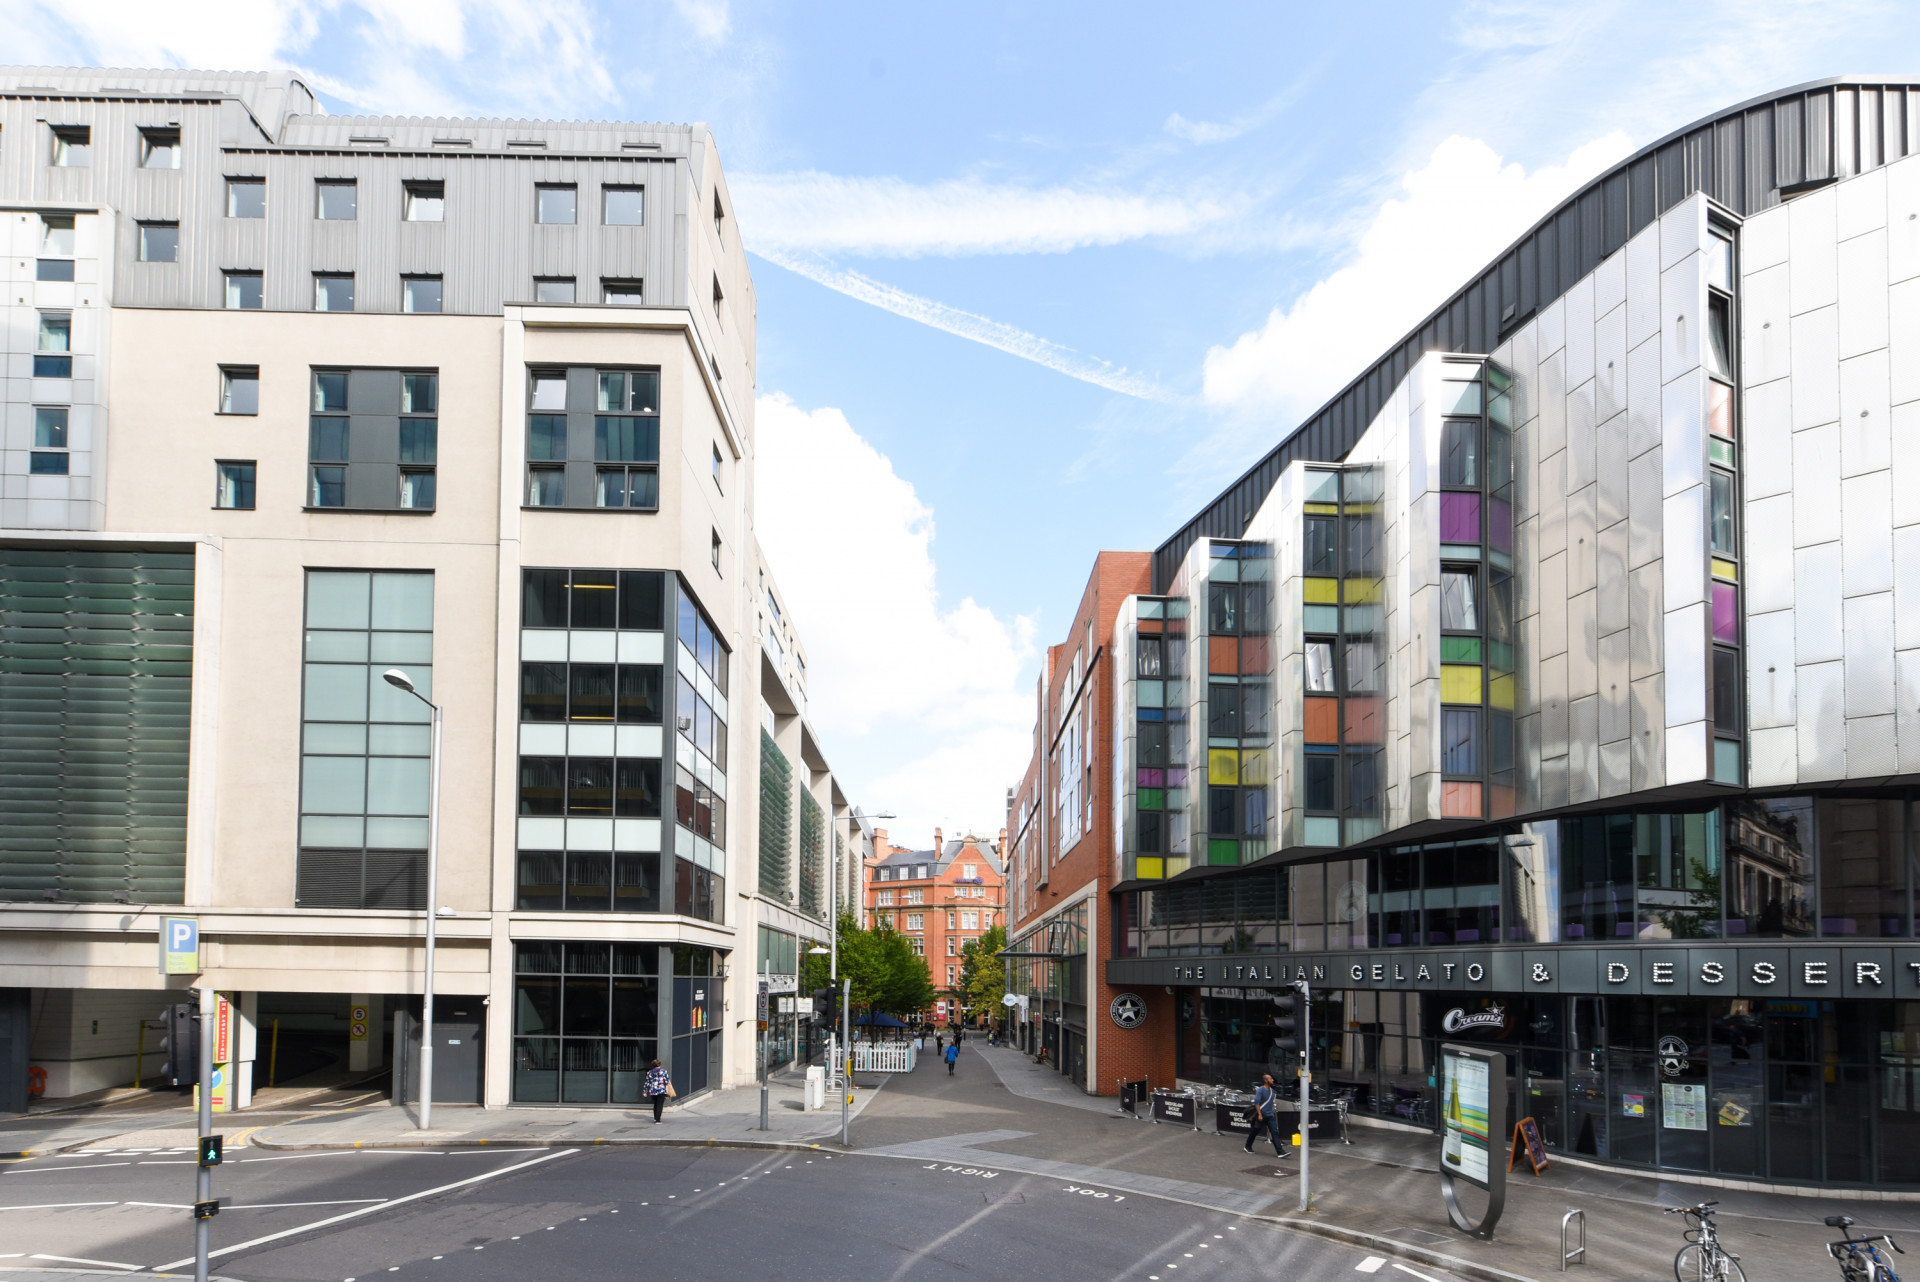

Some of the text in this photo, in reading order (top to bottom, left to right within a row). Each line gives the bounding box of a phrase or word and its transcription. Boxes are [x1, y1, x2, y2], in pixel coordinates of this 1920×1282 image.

[173, 923, 191, 949] P
[1174, 966, 1204, 979] THE
[1223, 965, 1325, 979] ITALIAN
[1350, 963, 1484, 981] GELATO
[1532, 963, 1550, 982] &
[922, 1163, 1126, 1203] LOOK RIGHT
